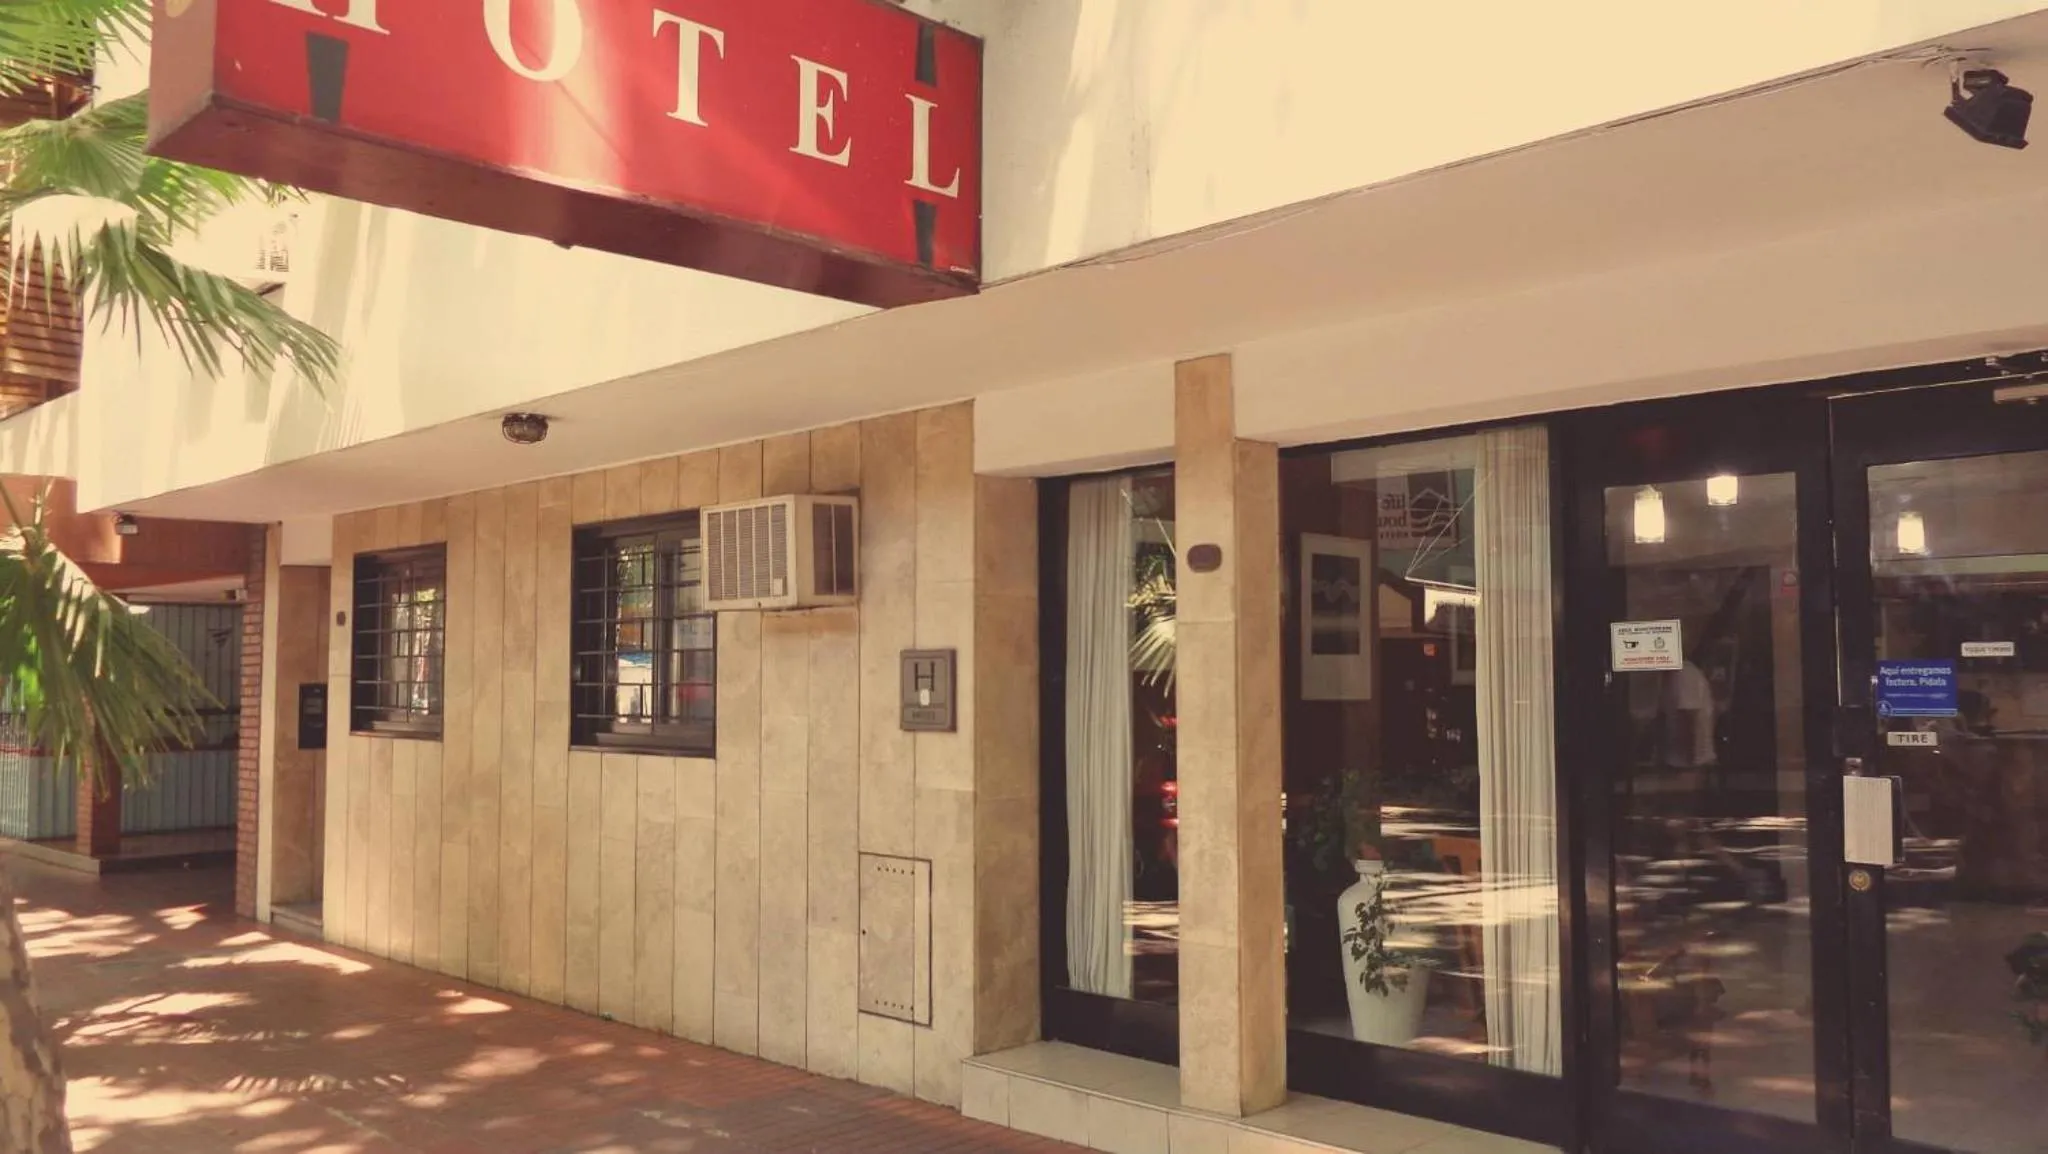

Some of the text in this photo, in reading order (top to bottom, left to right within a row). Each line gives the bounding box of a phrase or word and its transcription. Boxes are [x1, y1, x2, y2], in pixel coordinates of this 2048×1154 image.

[266, 0, 963, 198] OTEL
[914, 661, 935, 692] H
[1901, 667, 1952, 676] entregamos
[1897, 734, 1929, 744] TIRE
